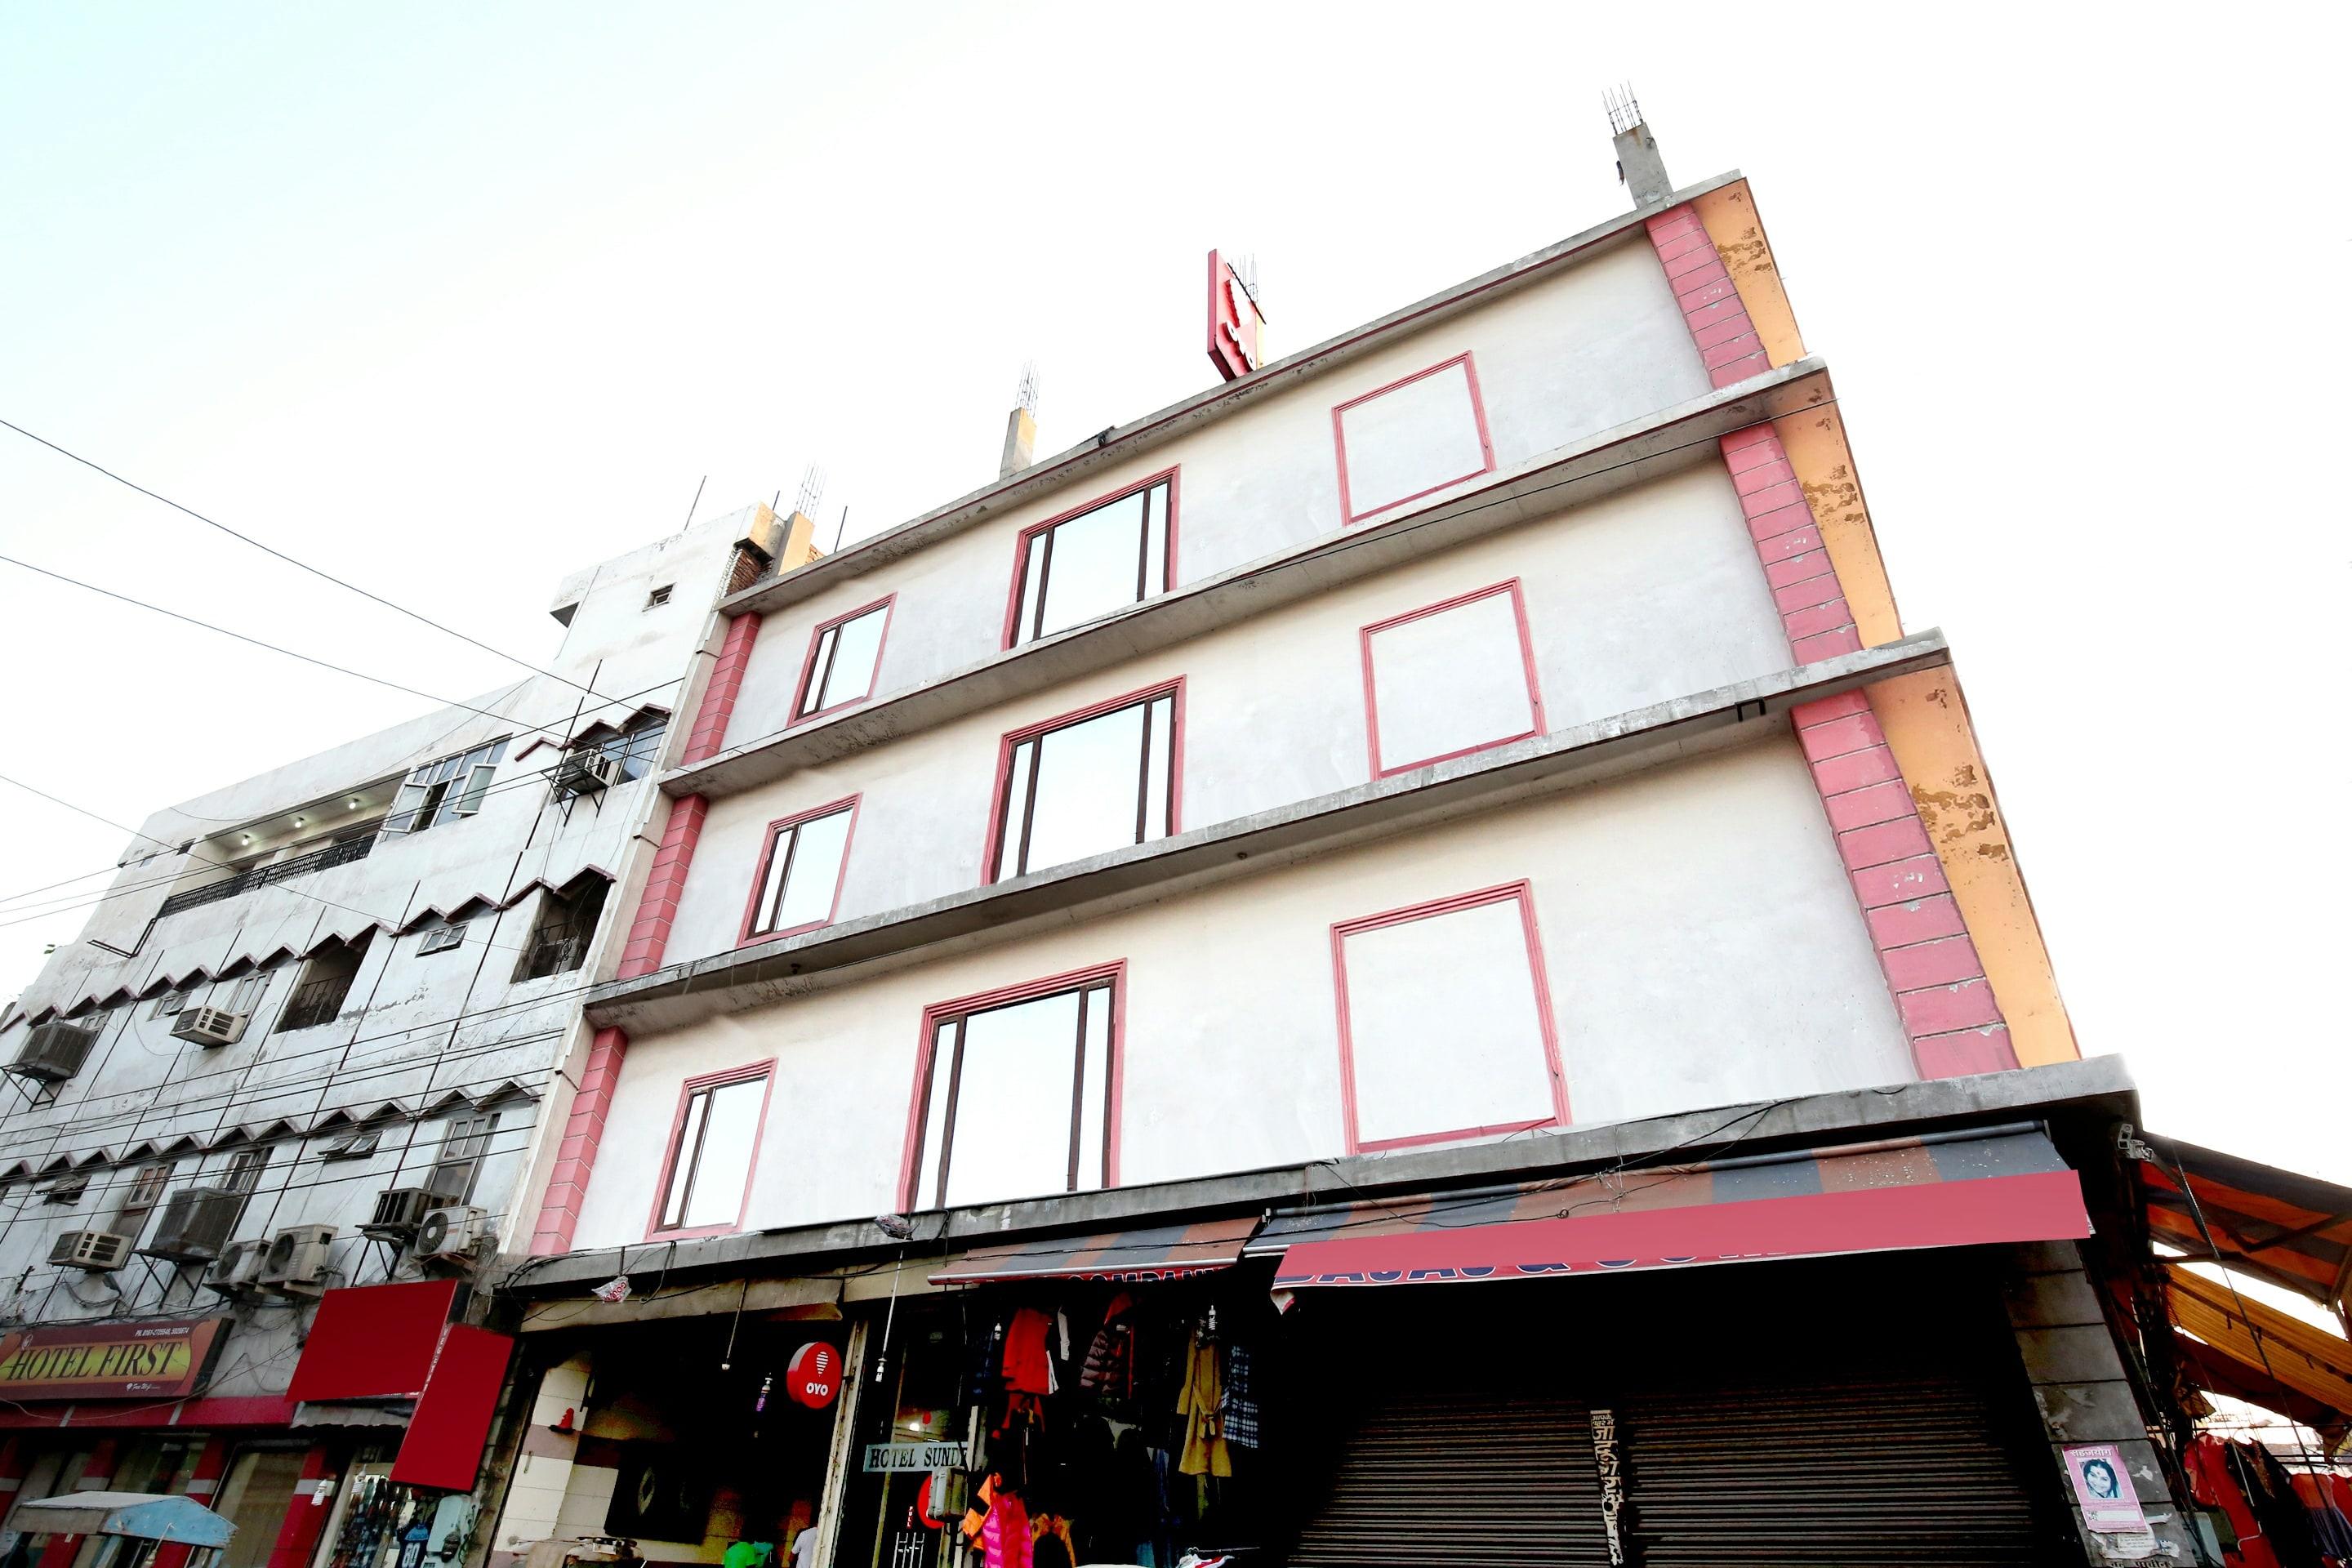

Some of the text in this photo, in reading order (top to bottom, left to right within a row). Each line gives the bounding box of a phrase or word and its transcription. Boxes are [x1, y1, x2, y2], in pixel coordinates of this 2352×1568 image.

[6, 1341, 182, 1380] HOTEL FIRST
[806, 1382, 829, 1396] OYO
[869, 1448, 916, 1468] HOTEL
